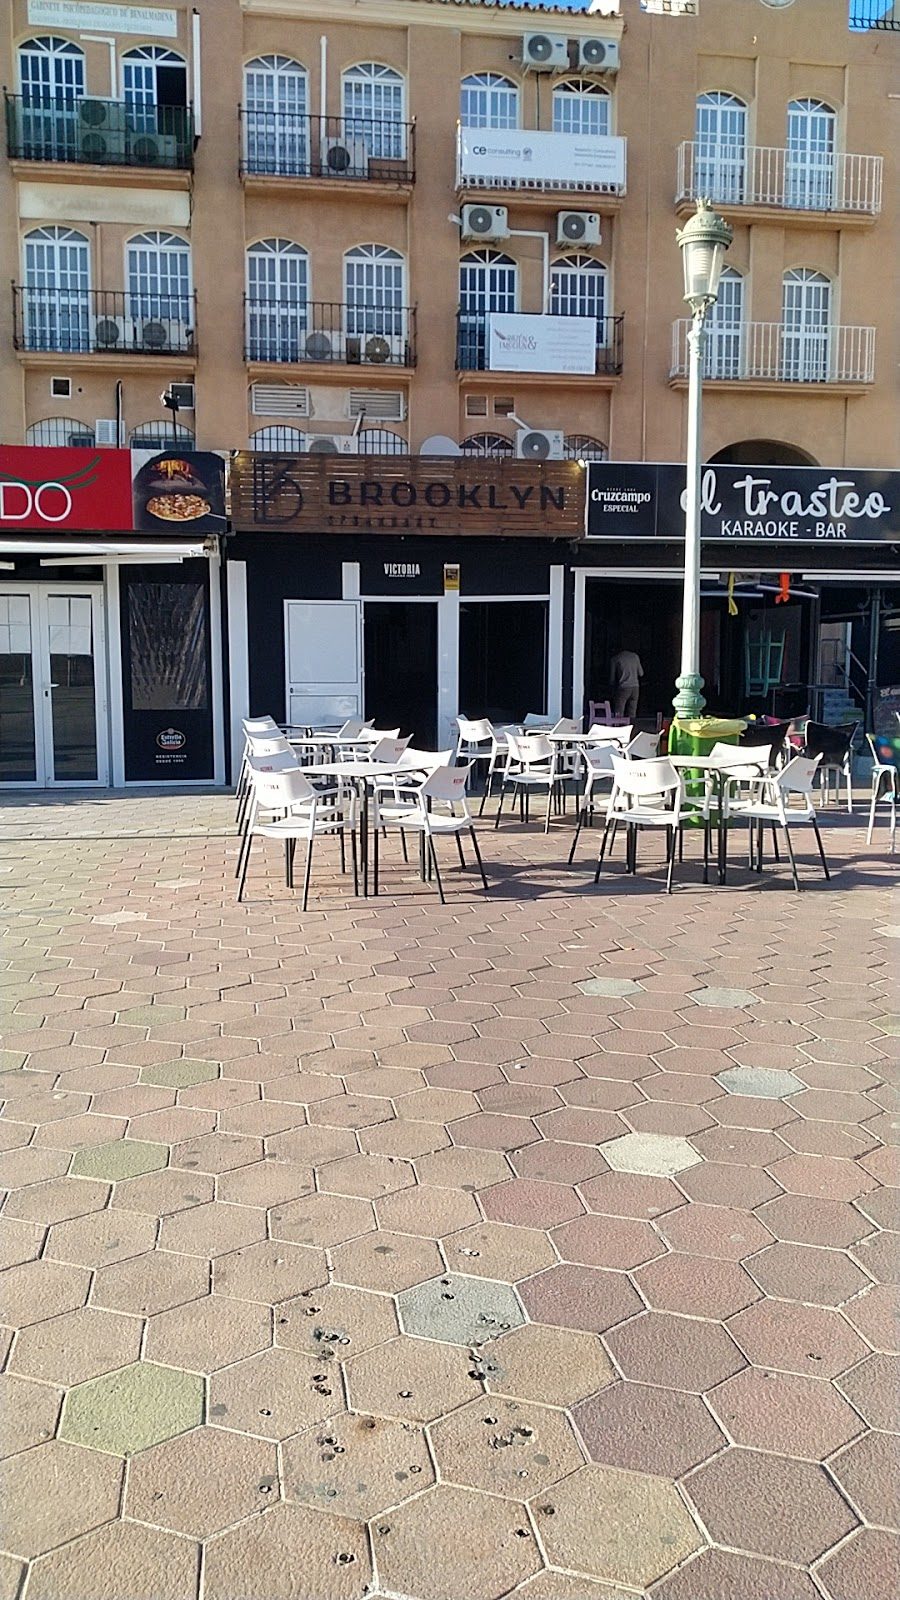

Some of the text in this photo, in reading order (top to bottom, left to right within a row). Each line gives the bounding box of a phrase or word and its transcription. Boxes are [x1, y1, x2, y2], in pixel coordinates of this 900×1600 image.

[472, 146, 487, 155] ce
[487, 148, 521, 157] consulting
[0, 481, 72, 522] DO
[328, 481, 565, 511] BROOKLYN
[591, 488, 651, 505] Cruzcampo
[732, 474, 891, 519] trasteo
[603, 504, 639, 513] ESPECIAL
[721, 519, 800, 538] KARAOKE
[815, 521, 847, 538] BAR
[383, 563, 421, 575] VICTORIA
